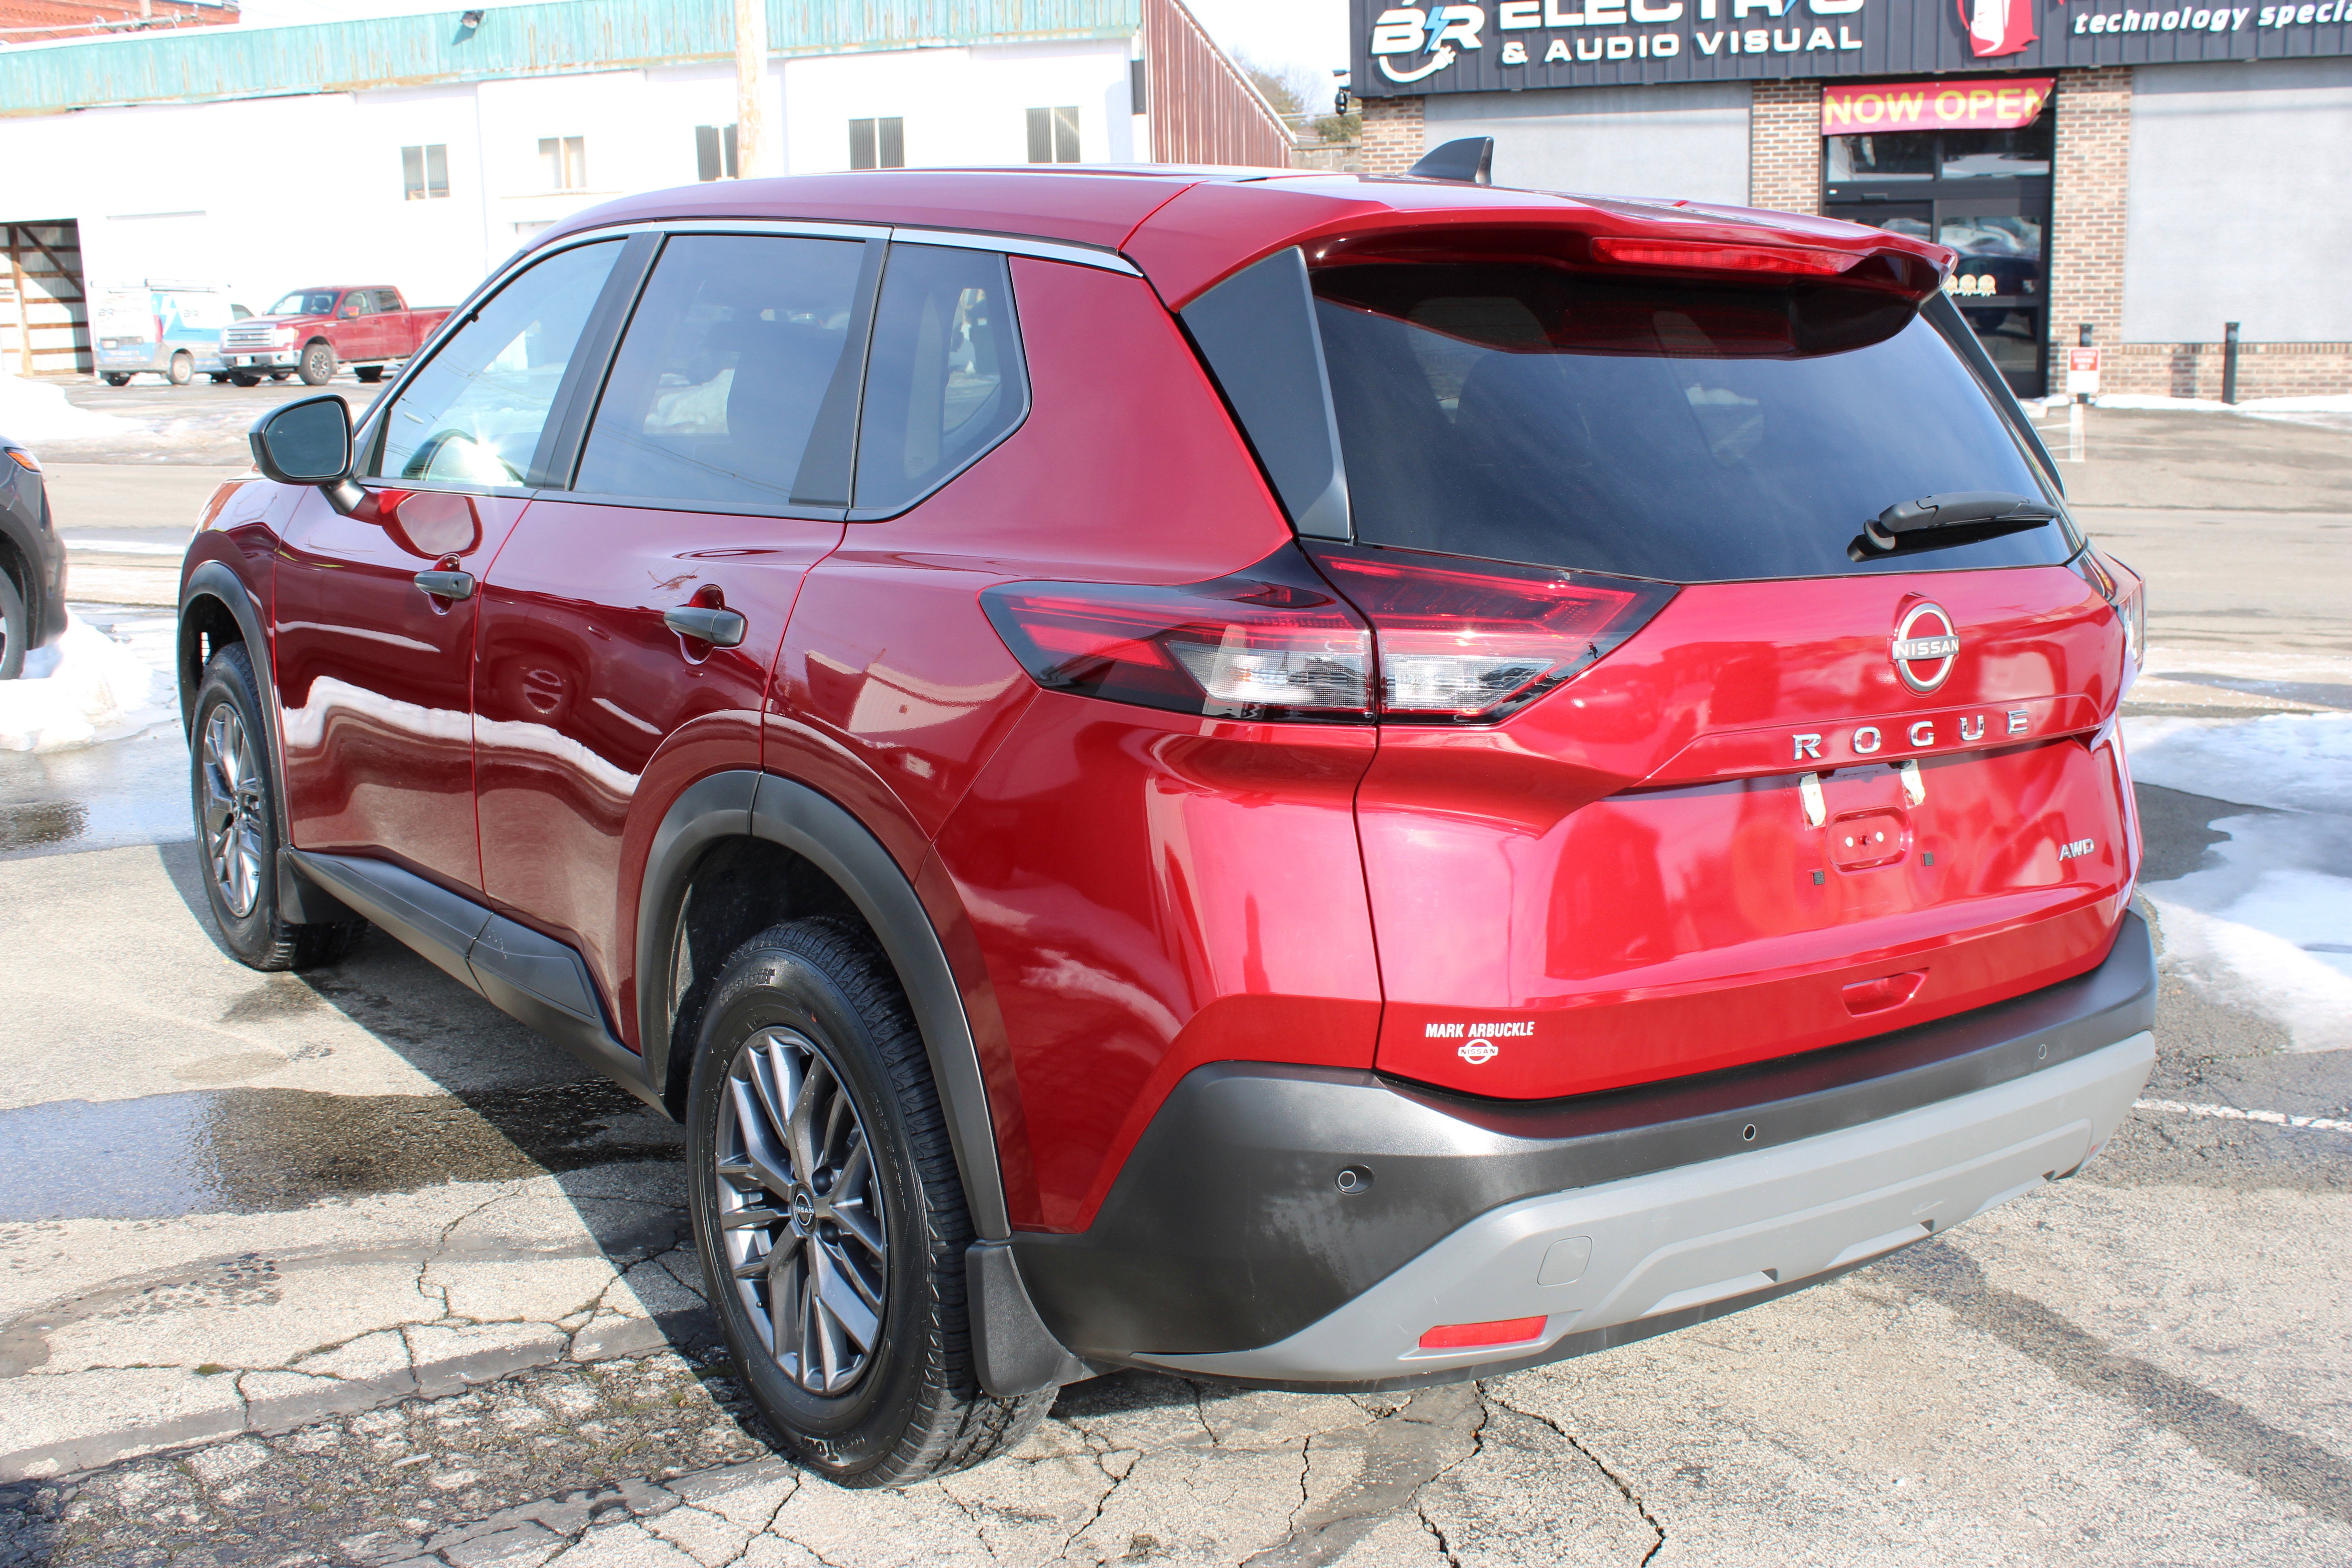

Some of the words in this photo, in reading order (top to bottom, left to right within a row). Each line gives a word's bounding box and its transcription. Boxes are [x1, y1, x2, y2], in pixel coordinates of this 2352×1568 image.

[2074, 7, 2250, 34] technology
[1501, 41, 1528, 64] &
[1544, 33, 1679, 62] AUDIO
[1696, 26, 1862, 55] VISUAL
[1824, 91, 1924, 126] NOW
[1895, 639, 1959, 657] NISSAN
[1792, 709, 2028, 761] ROGUE
[2058, 838, 2095, 861] AWD
[1425, 1023, 1465, 1038] MARK
[1468, 1021, 1535, 1038] ARBUCKLE
[794, 1205, 814, 1214] SSAN
